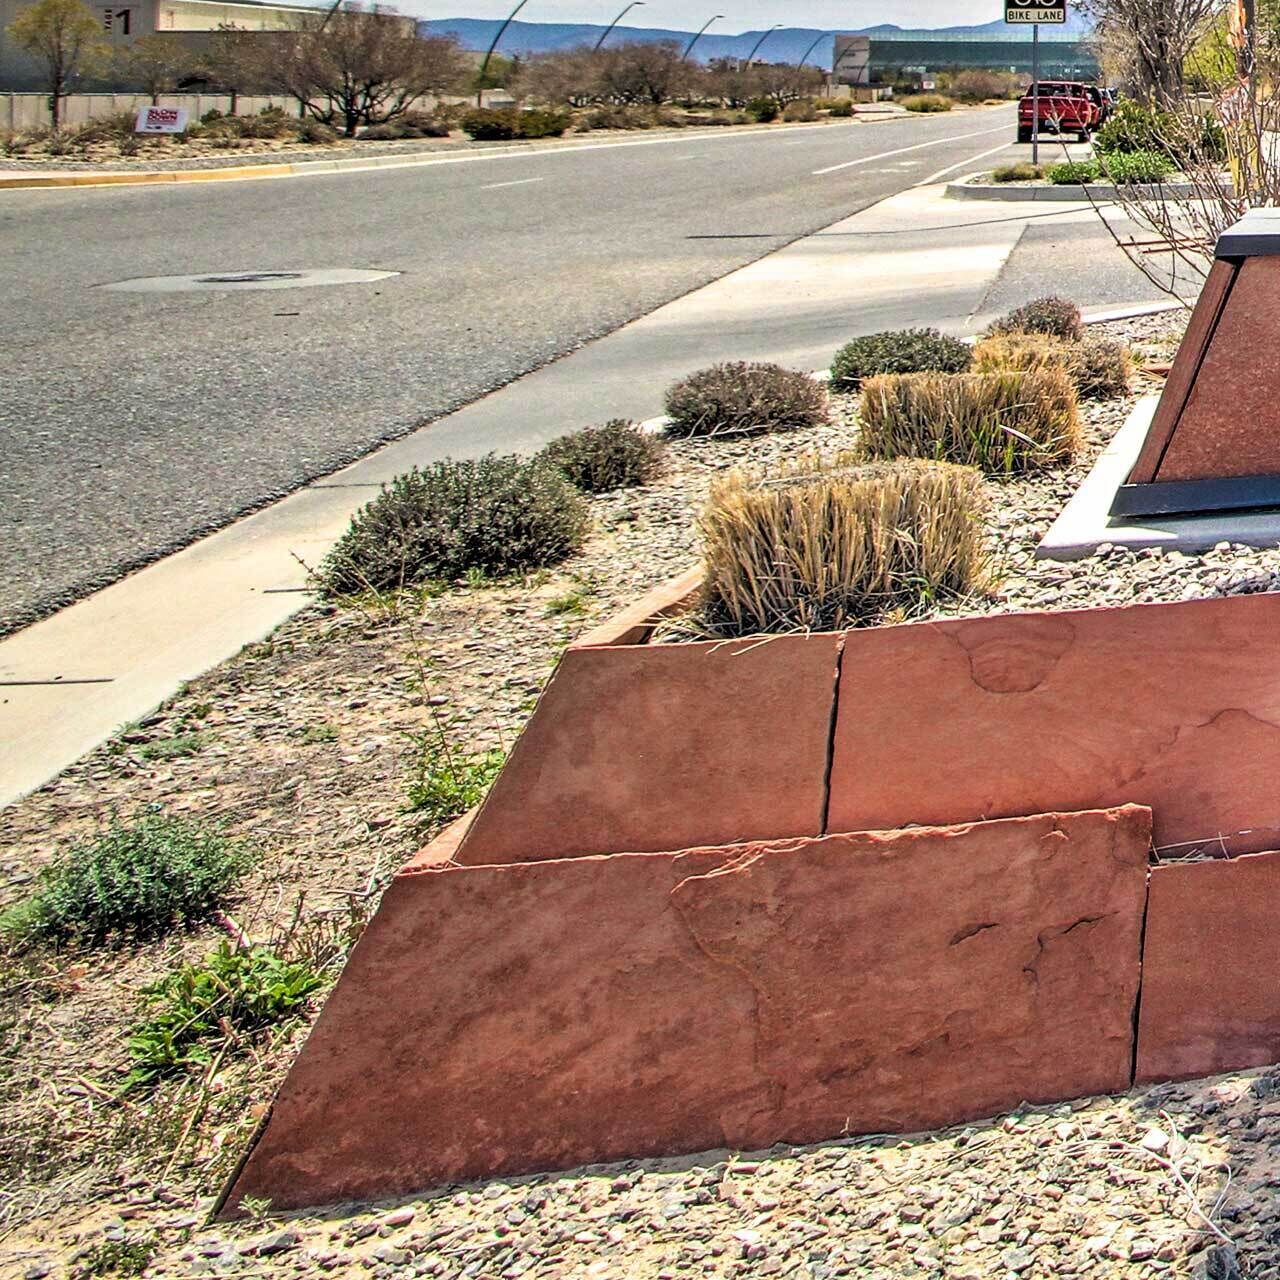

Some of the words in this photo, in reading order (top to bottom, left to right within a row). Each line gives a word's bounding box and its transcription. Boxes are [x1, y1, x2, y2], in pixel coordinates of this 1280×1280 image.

[115, 9, 130, 35] 1
[1008, 11, 1031, 20] BIKE
[1037, 11, 1062, 20] LANE
